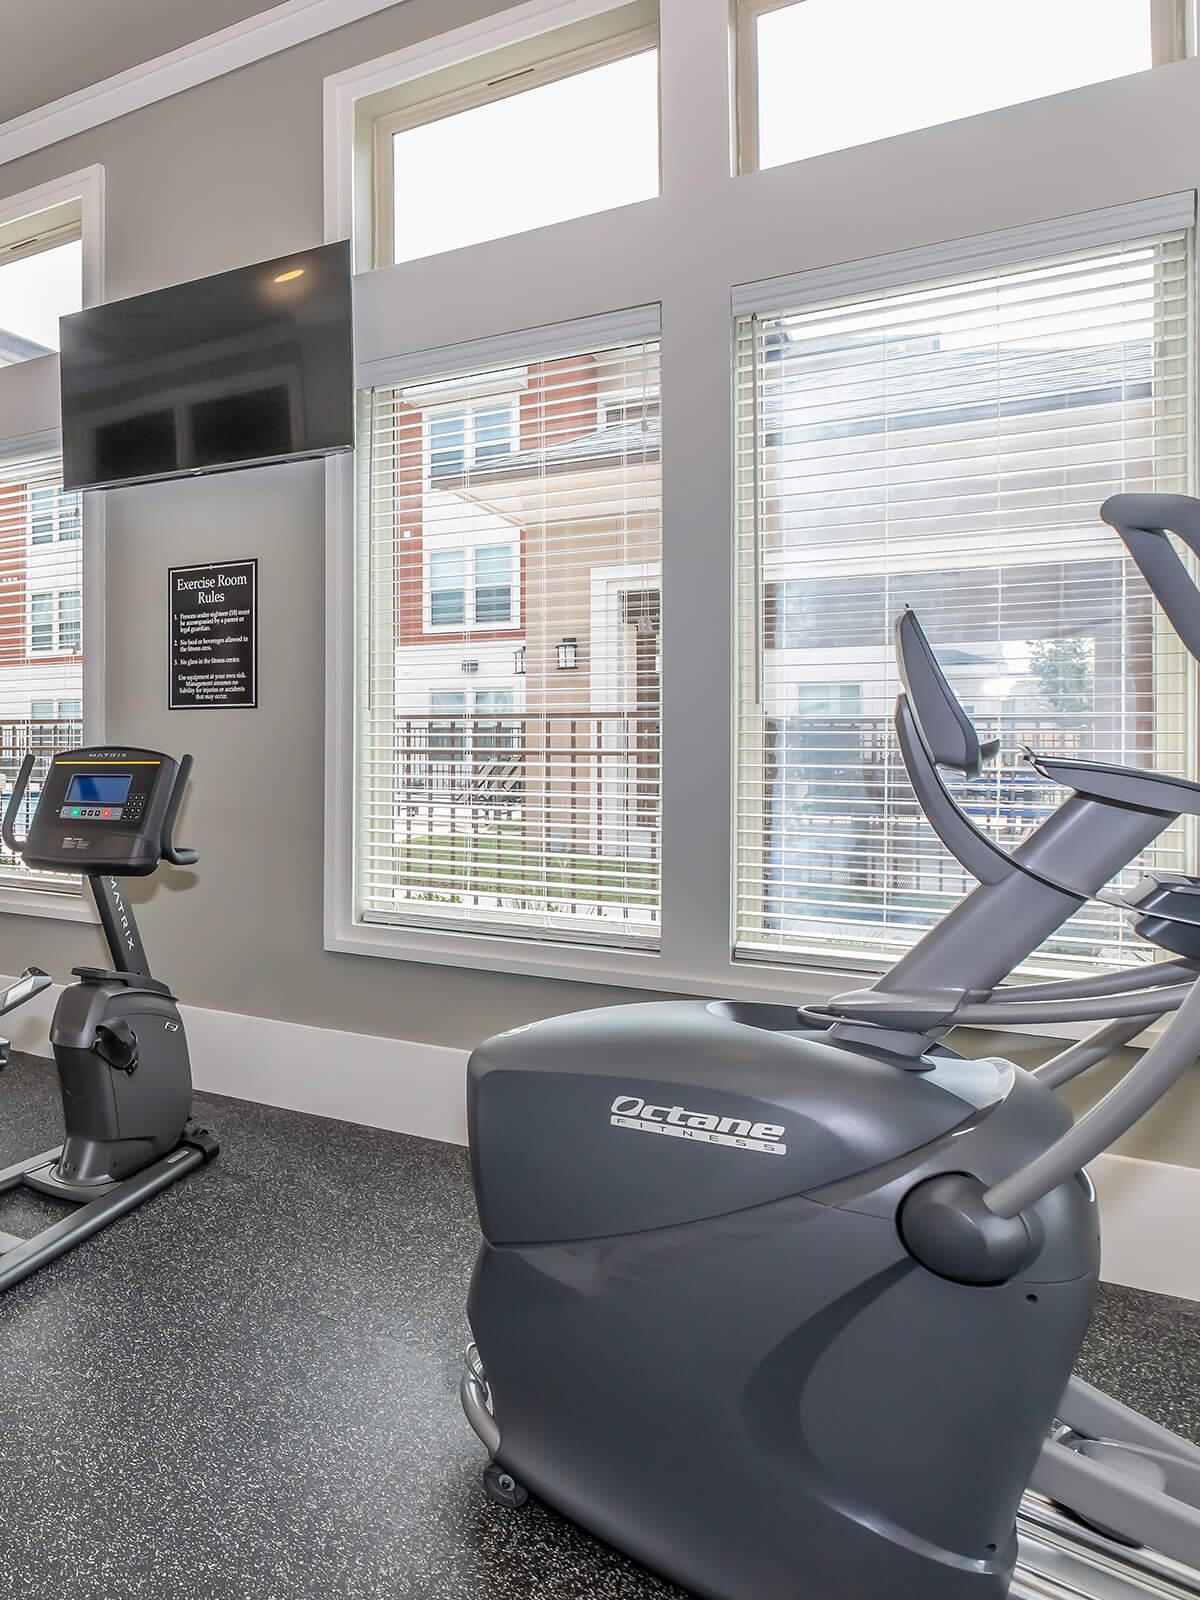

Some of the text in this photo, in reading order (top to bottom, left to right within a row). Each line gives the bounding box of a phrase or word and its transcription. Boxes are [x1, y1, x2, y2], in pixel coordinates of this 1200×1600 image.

[177, 574, 247, 591] Exercise Room
[198, 590, 225, 604] Rules
[108, 876, 135, 950] MATRIX
[610, 1095, 785, 1140] Octane
[616, 1118, 775, 1151] FITNESS
